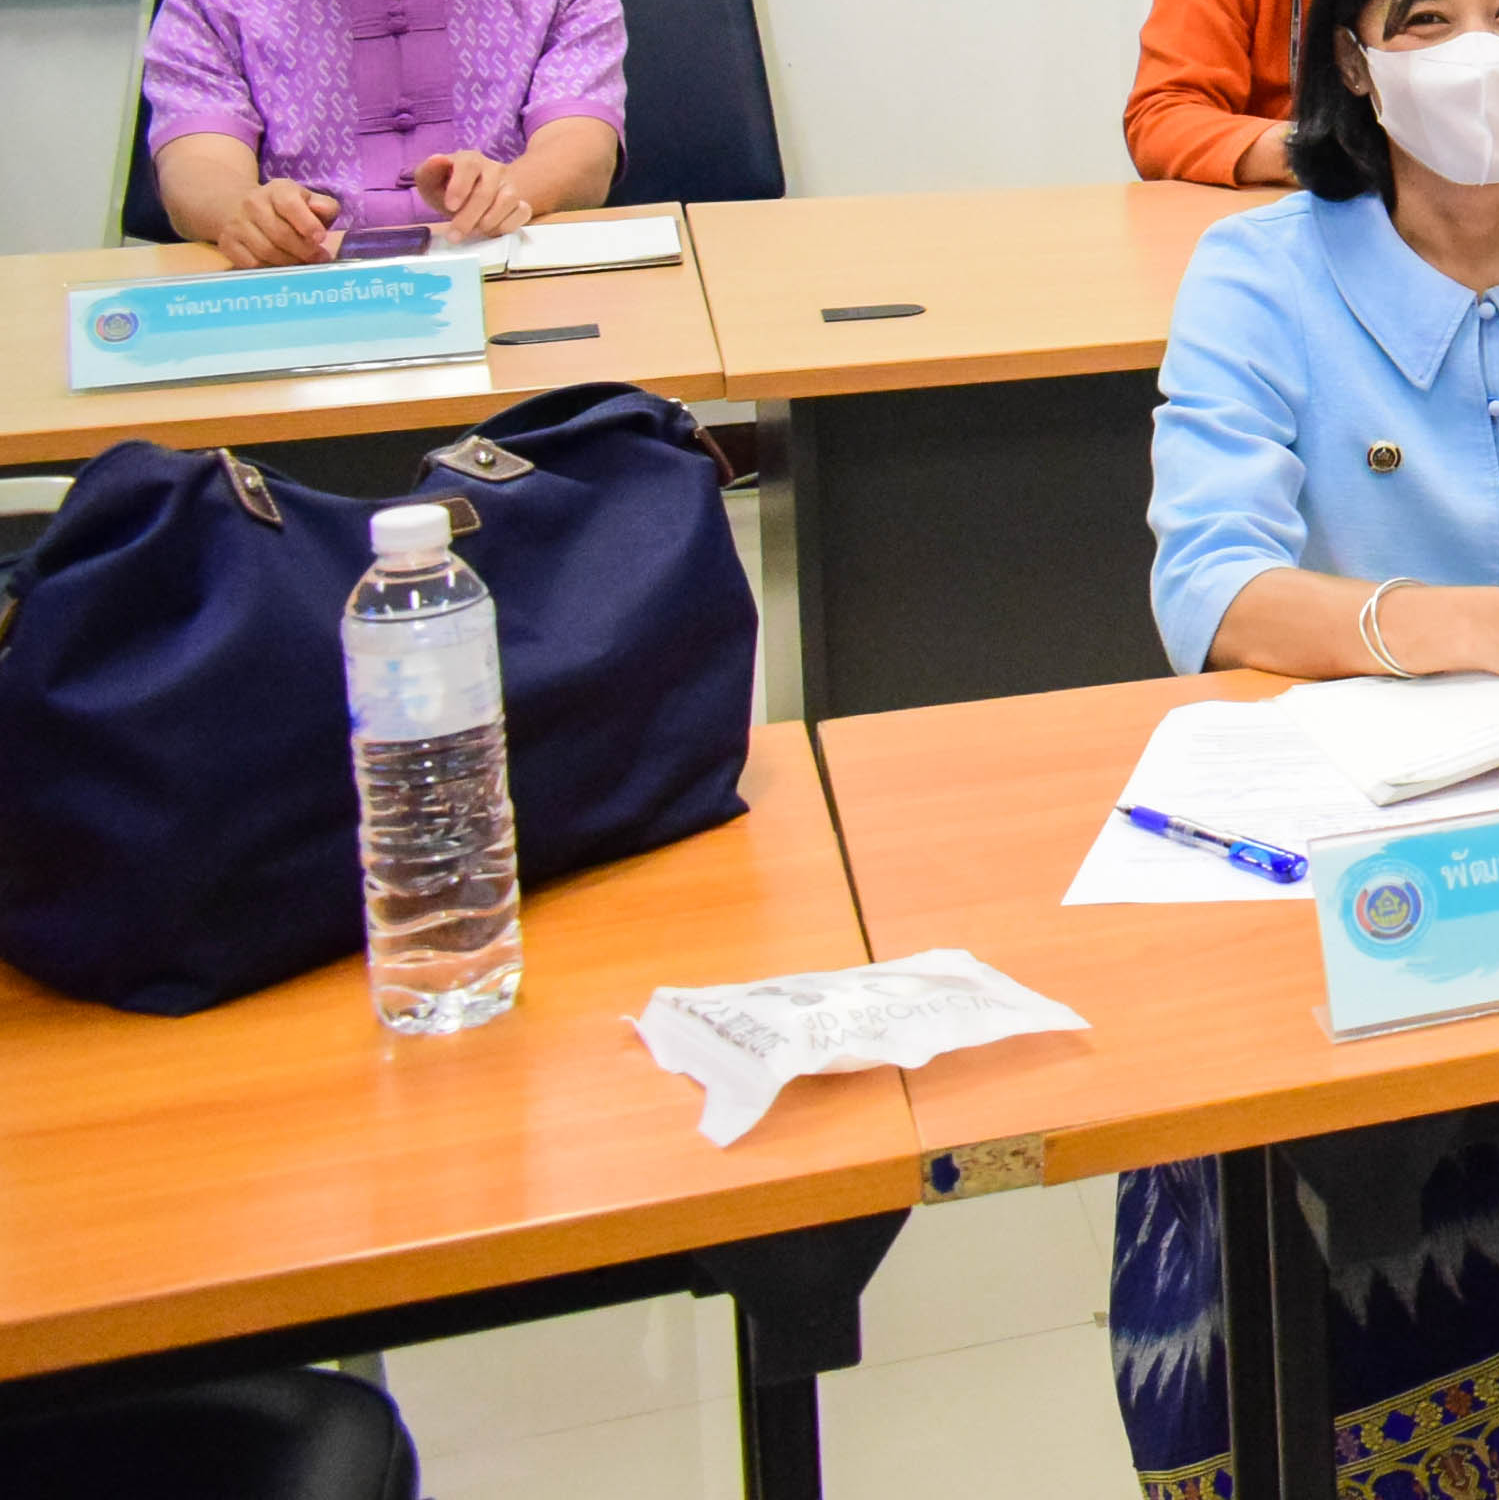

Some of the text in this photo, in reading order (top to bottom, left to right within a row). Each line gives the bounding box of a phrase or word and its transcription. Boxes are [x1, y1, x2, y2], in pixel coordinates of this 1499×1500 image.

[166, 277, 415, 317] พัฒนาการอำเภอสันติสุข
